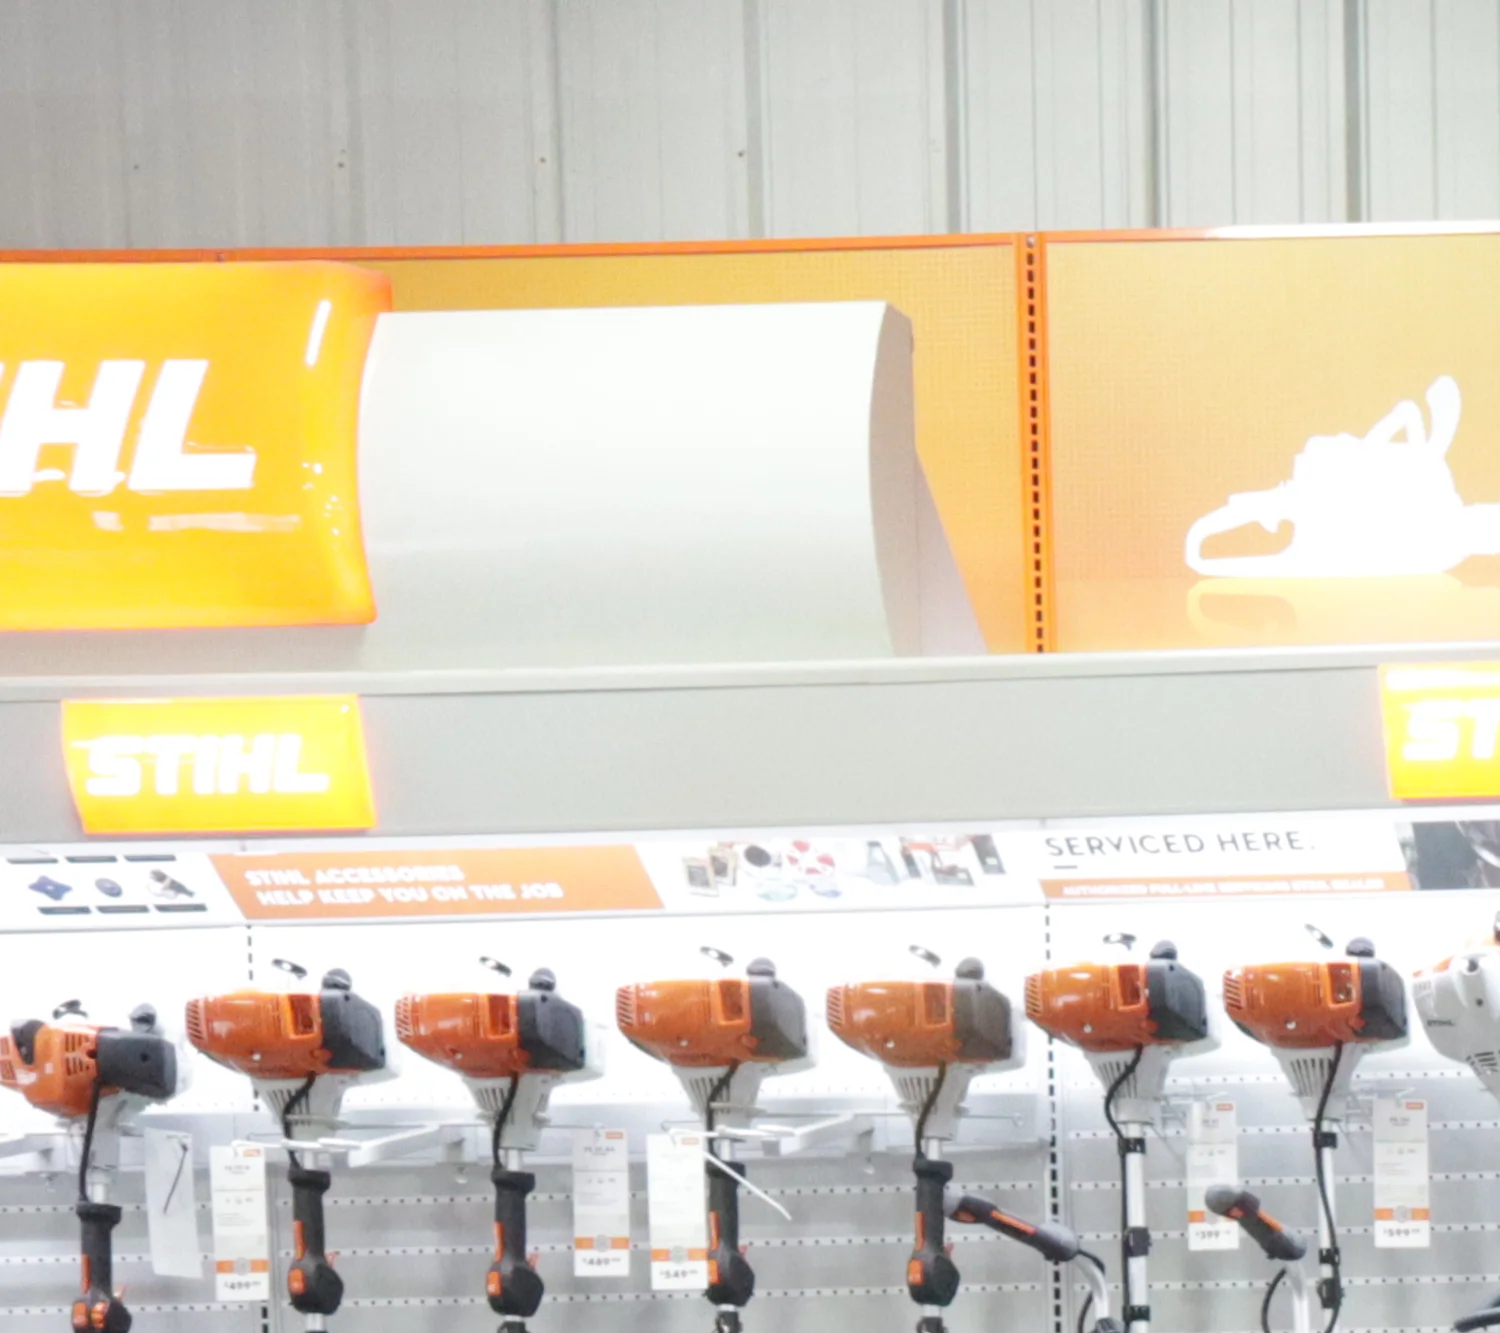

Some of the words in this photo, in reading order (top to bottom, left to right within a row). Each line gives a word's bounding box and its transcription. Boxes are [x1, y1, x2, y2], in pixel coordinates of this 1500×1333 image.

[0, 358, 256, 494] HL
[84, 731, 330, 797] STIHL
[1045, 832, 1205, 857] SERVICED
[1216, 830, 1316, 853] HERE.
[245, 869, 310, 885] STIHL
[378, 887, 428, 902] YOU
